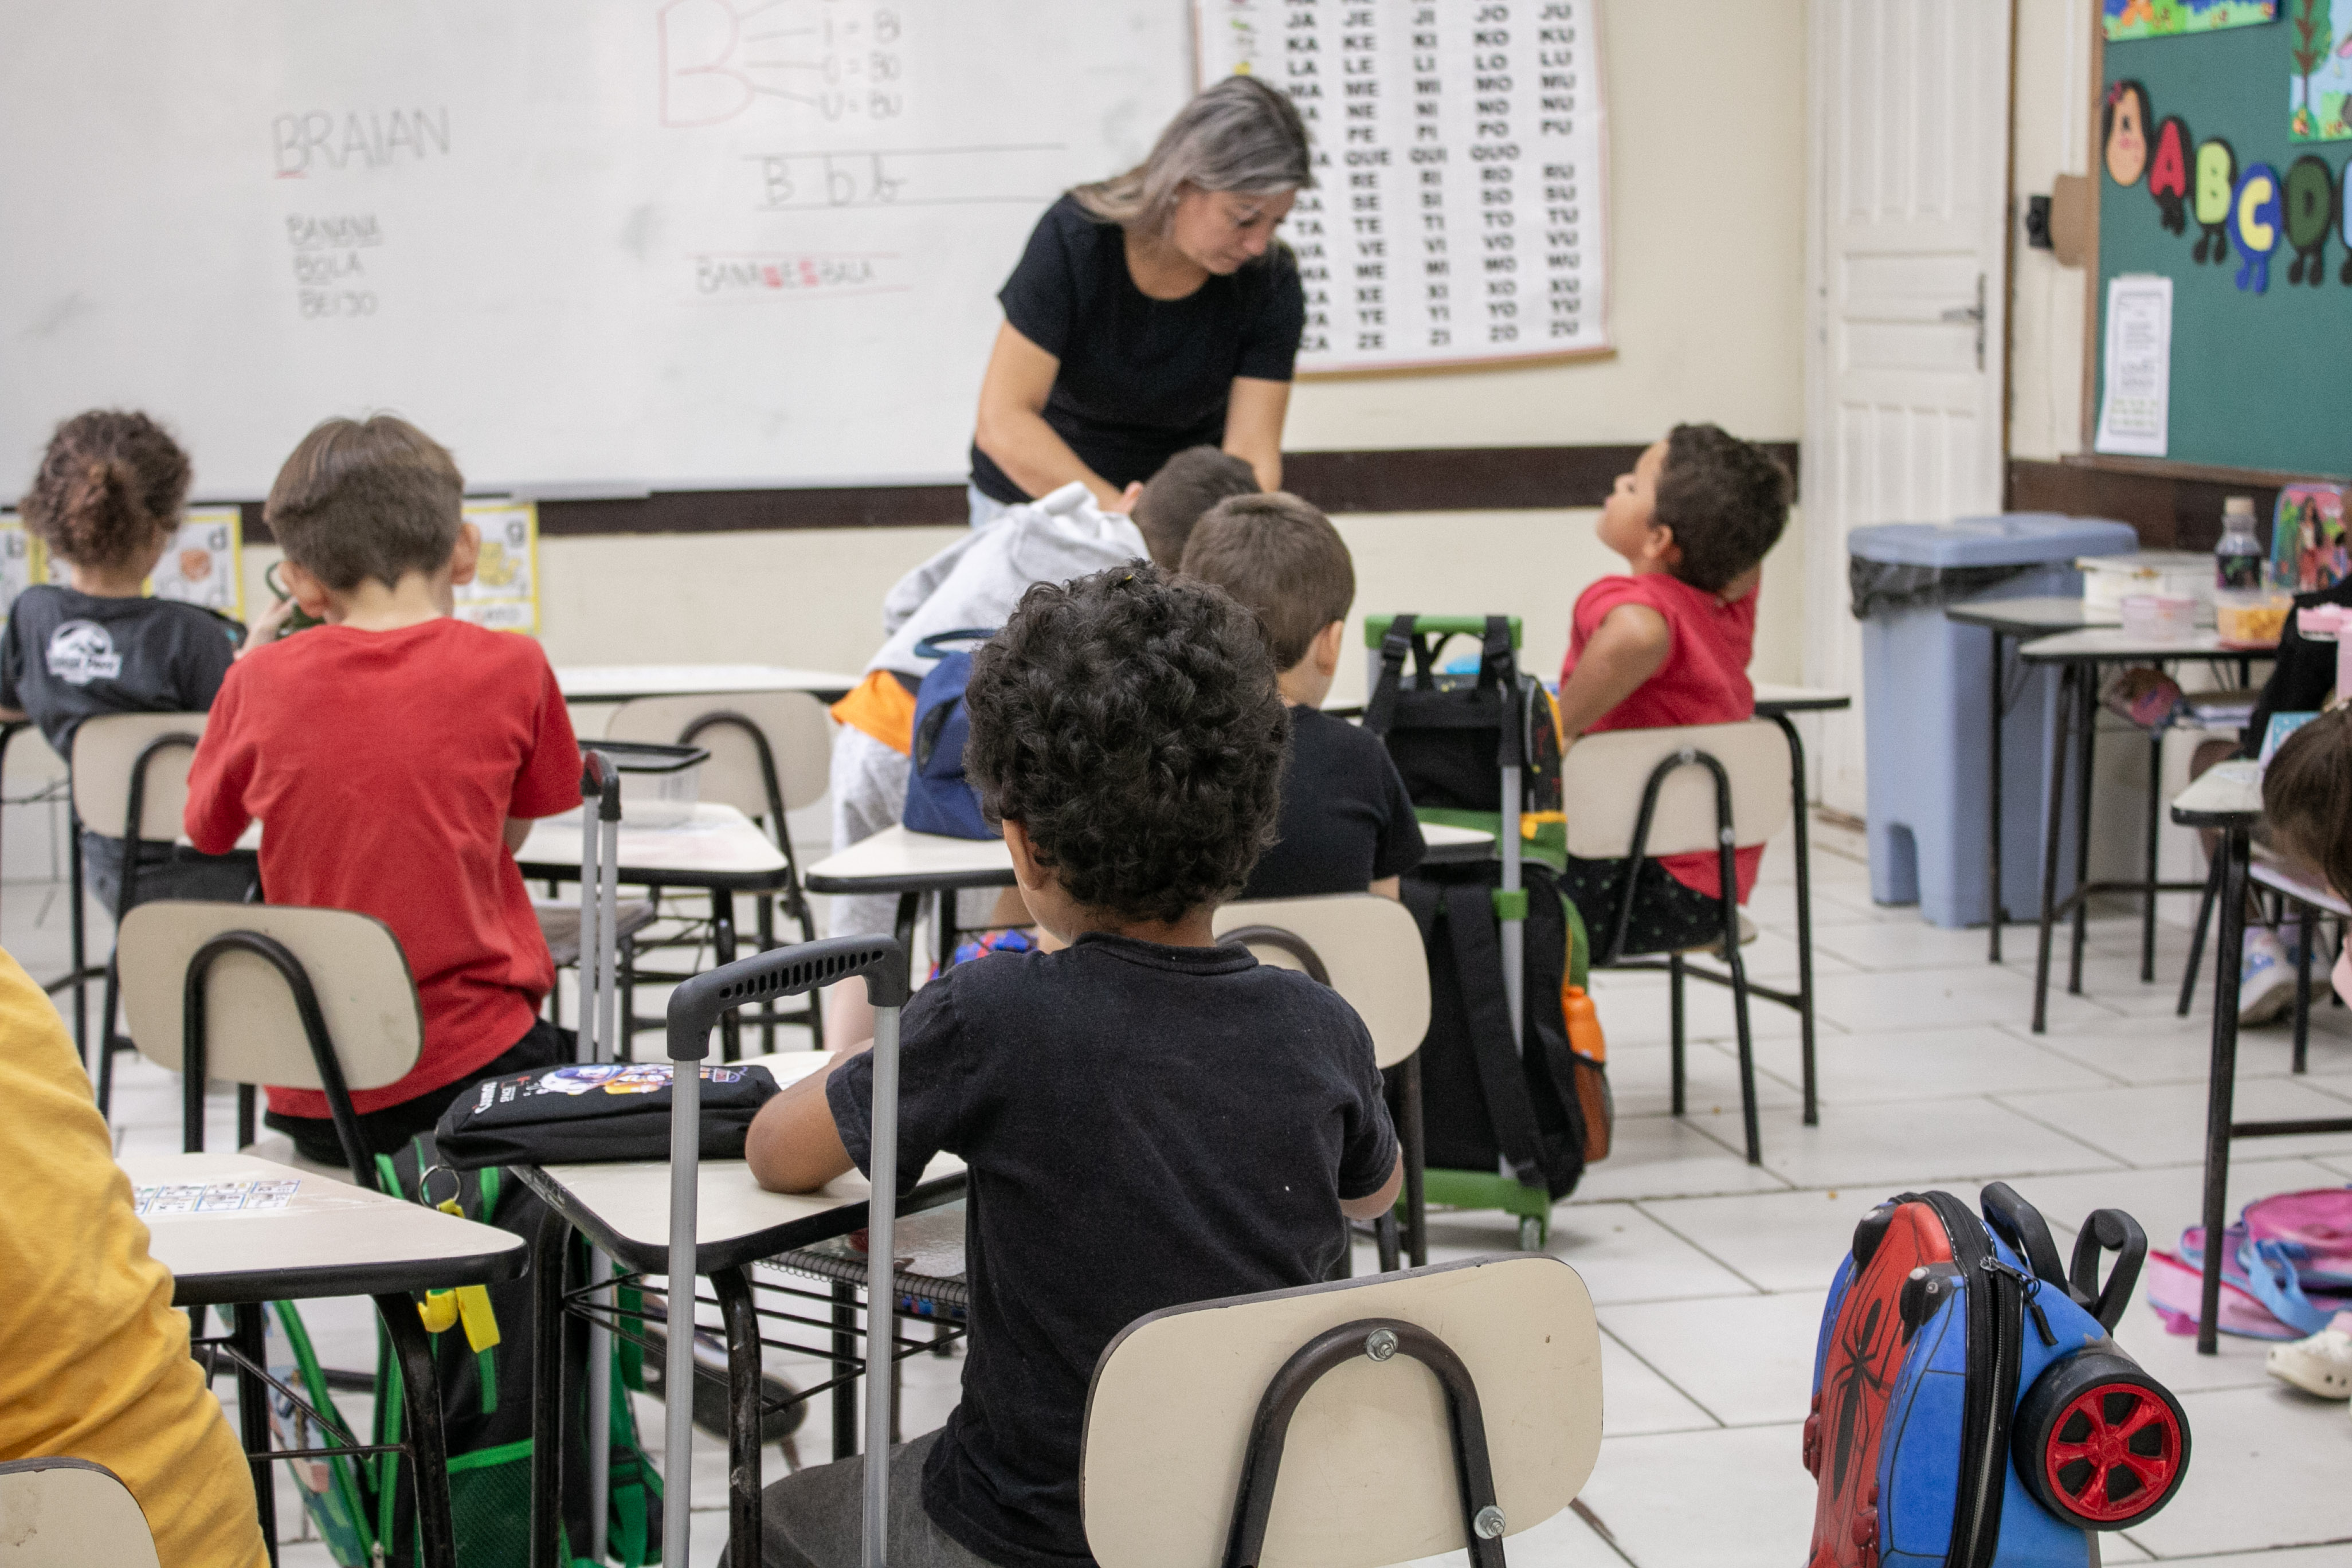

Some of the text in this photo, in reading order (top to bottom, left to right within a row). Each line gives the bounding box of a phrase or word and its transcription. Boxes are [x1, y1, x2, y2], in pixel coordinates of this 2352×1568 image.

[1287, 3, 1573, 29] JA JE JI JO JU
[1286, 37, 1319, 52] KA
[1343, 35, 1374, 50] KE
[1474, 30, 1509, 46] KO
[1539, 29, 1575, 43] KU
[1287, 50, 1573, 77] LA LE LI LO LU
[1344, 81, 1377, 97] ME
[1475, 76, 1512, 92] MO
[1540, 74, 1575, 89] MU
[1300, 105, 1320, 120] A
[1347, 103, 1375, 119] NE
[1476, 99, 1509, 115] NO
[1541, 97, 1574, 111] NU
[1347, 119, 1572, 143] PE PI PO PU
[1344, 148, 1390, 167] QUE
[762, 155, 797, 206] B
[1481, 167, 1512, 182] RO
[1543, 164, 1574, 179] RU
[1352, 194, 1379, 211] SE
[1421, 191, 1442, 209] SI
[1481, 187, 1513, 206] SO
[1545, 186, 1576, 202] SU
[1295, 207, 1579, 235] TA TE TI TO TU
[1358, 240, 1385, 257] VE
[1424, 237, 1447, 254] VI
[1483, 233, 1515, 250] VO
[1546, 230, 1578, 247] VU
[1355, 263, 1384, 279] WE
[1357, 286, 1382, 303] XE
[1487, 279, 1517, 296] XO
[1550, 279, 1580, 295] XU
[1358, 308, 1385, 324] YE
[1428, 304, 1450, 321] YI
[1487, 300, 1518, 318] YO
[1550, 297, 1581, 314] YU
[1357, 332, 1383, 350] ZE
[1429, 328, 1451, 347] ZI
[1489, 323, 1519, 343] ZO
[1549, 317, 1580, 338] ZU
[208, 526, 228, 551] d
[505, 519, 526, 548] g
